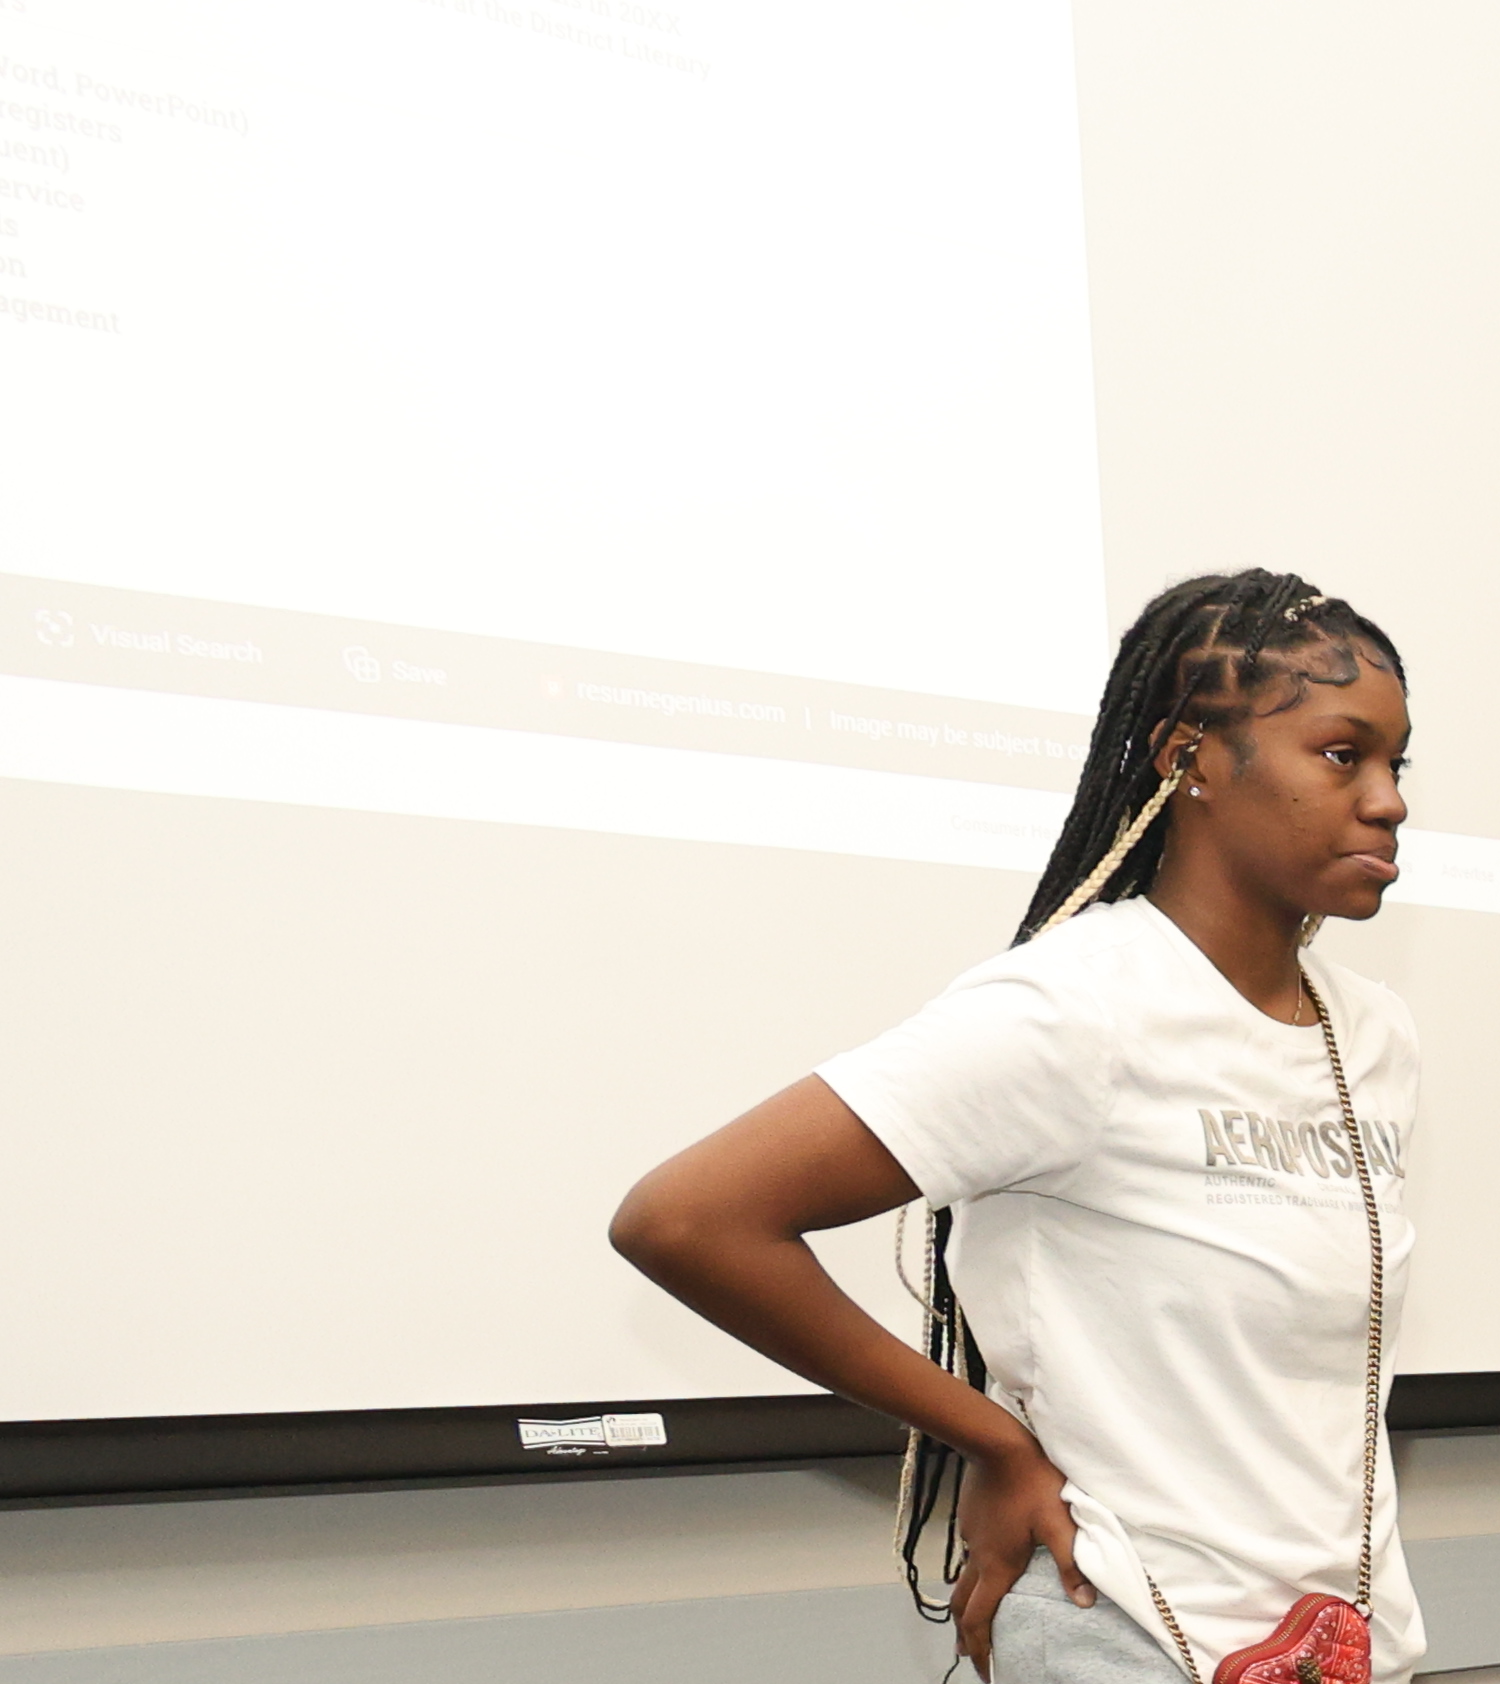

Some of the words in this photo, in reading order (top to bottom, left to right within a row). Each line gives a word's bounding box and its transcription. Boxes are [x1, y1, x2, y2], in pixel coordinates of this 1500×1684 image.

[89, 621, 170, 654] Visual
[176, 632, 263, 665] Search
[391, 658, 448, 686] Save
[575, 679, 786, 725] resumegenius.com
[829, 709, 893, 741] Image
[897, 717, 939, 748] may
[943, 723, 969, 746] be
[973, 728, 1041, 758] subject
[1204, 1175, 1276, 1189] AUTHENTIC
[1206, 1194, 1284, 1206] REGISTERED
